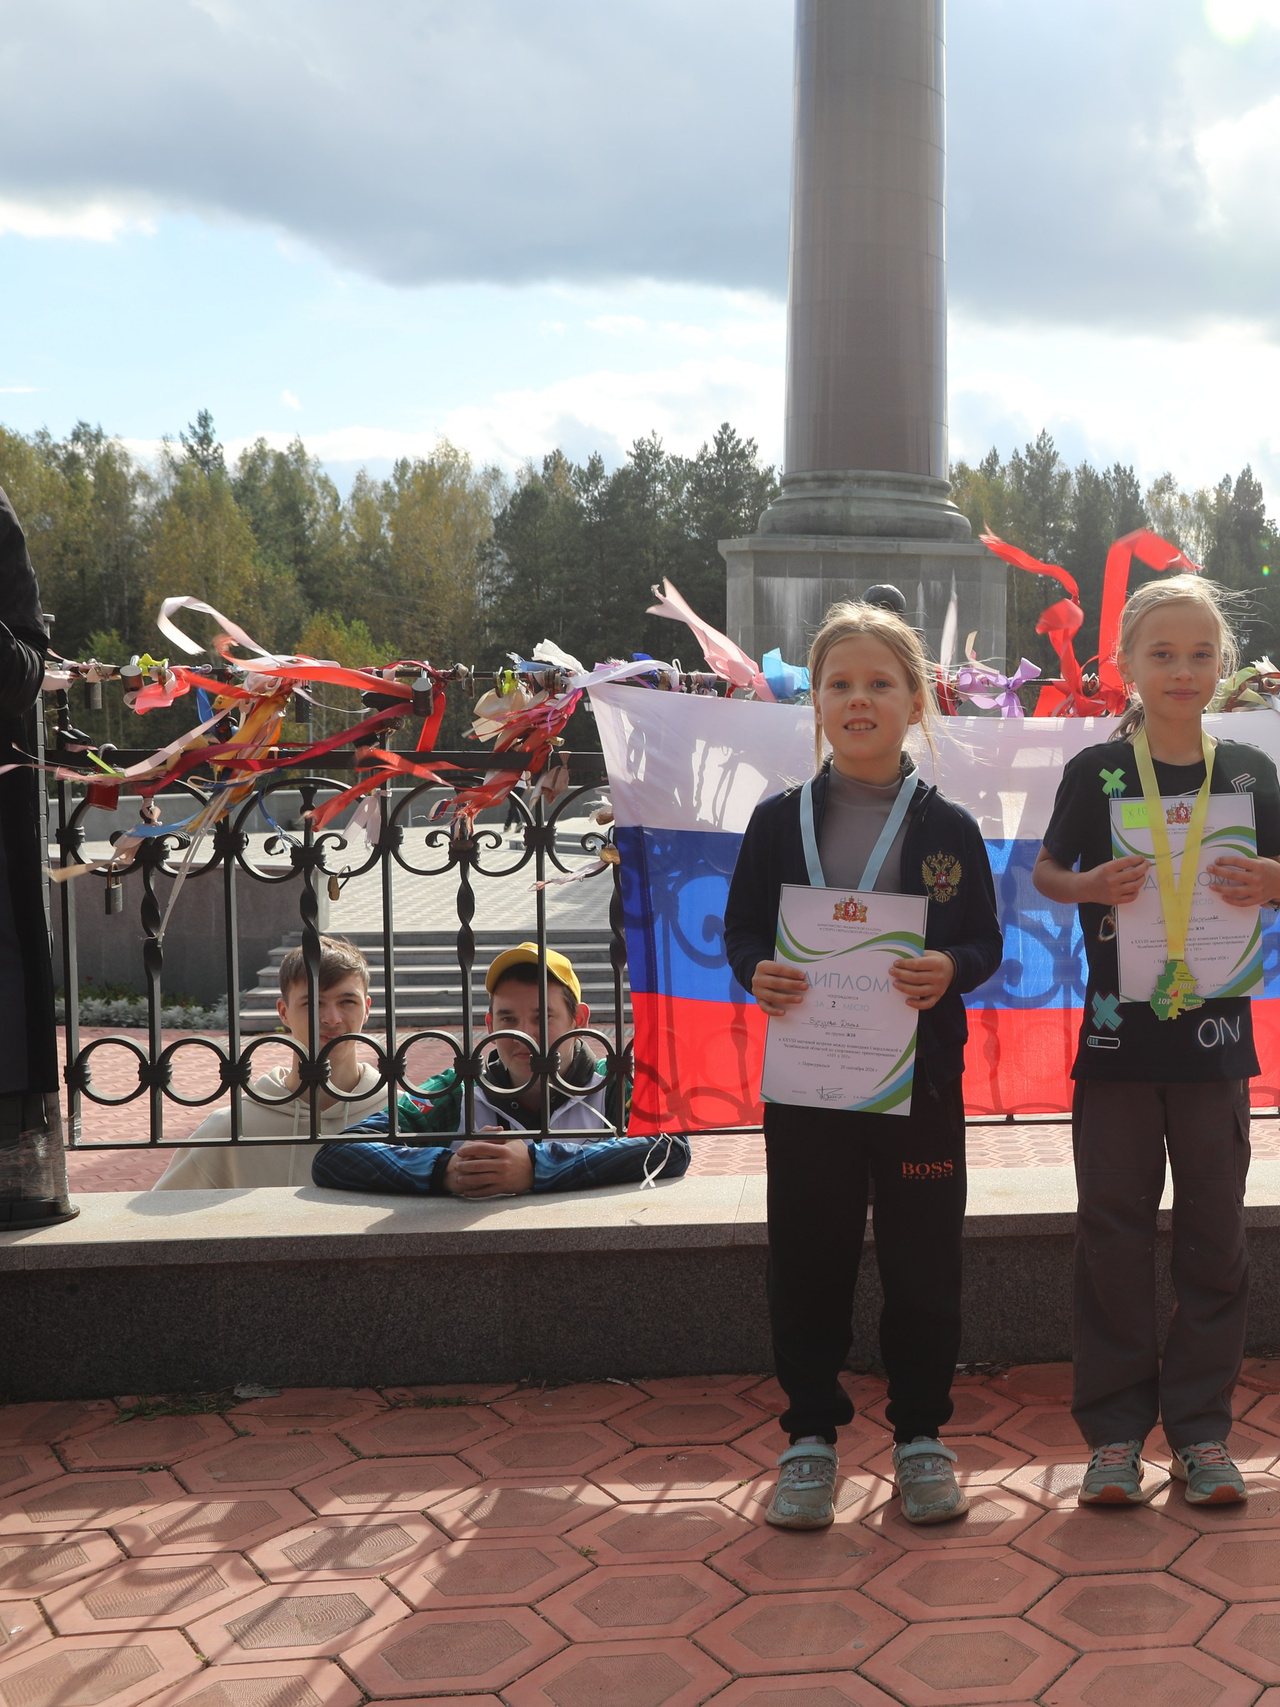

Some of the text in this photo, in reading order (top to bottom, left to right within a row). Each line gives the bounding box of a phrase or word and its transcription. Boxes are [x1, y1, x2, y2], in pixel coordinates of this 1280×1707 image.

[843, 1004, 870, 1012] МЕСТО
[1198, 1016, 1240, 1048] ON
[902, 1160, 953, 1175] BOSS
